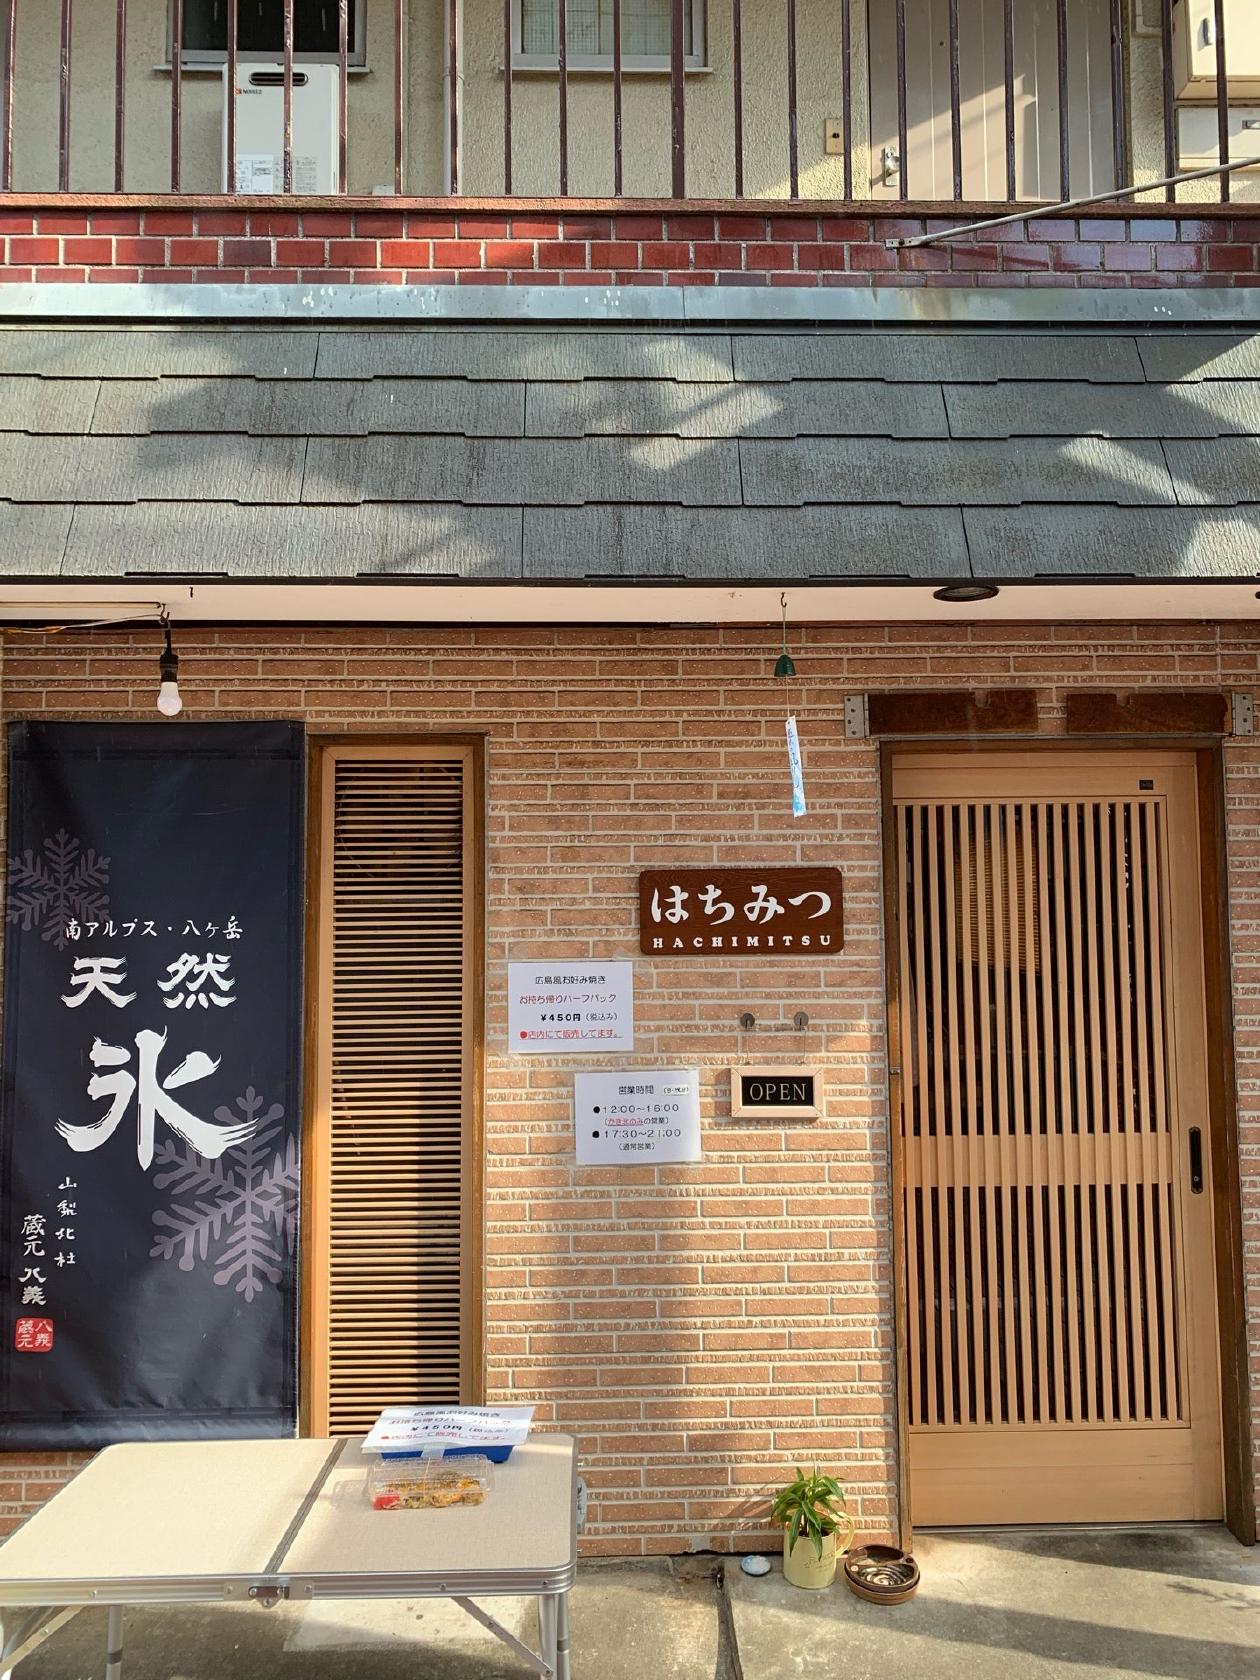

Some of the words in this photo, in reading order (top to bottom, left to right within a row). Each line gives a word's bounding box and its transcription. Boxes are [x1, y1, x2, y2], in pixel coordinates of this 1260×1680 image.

[651, 884, 832, 926] はちみつ
[652, 934, 831, 949] HACHIMITSU
[60, 952, 238, 1010] 天然
[534, 975, 607, 985] 広島風お好み焼き
[519, 993, 617, 1005] お持ち帰りハーフパック
[53, 1025, 260, 1172] 氷
[618, 1084, 655, 1095] 営業時間
[749, 1083, 807, 1101] OPEN
[53, 1176, 78, 1269] 山梨北杜
